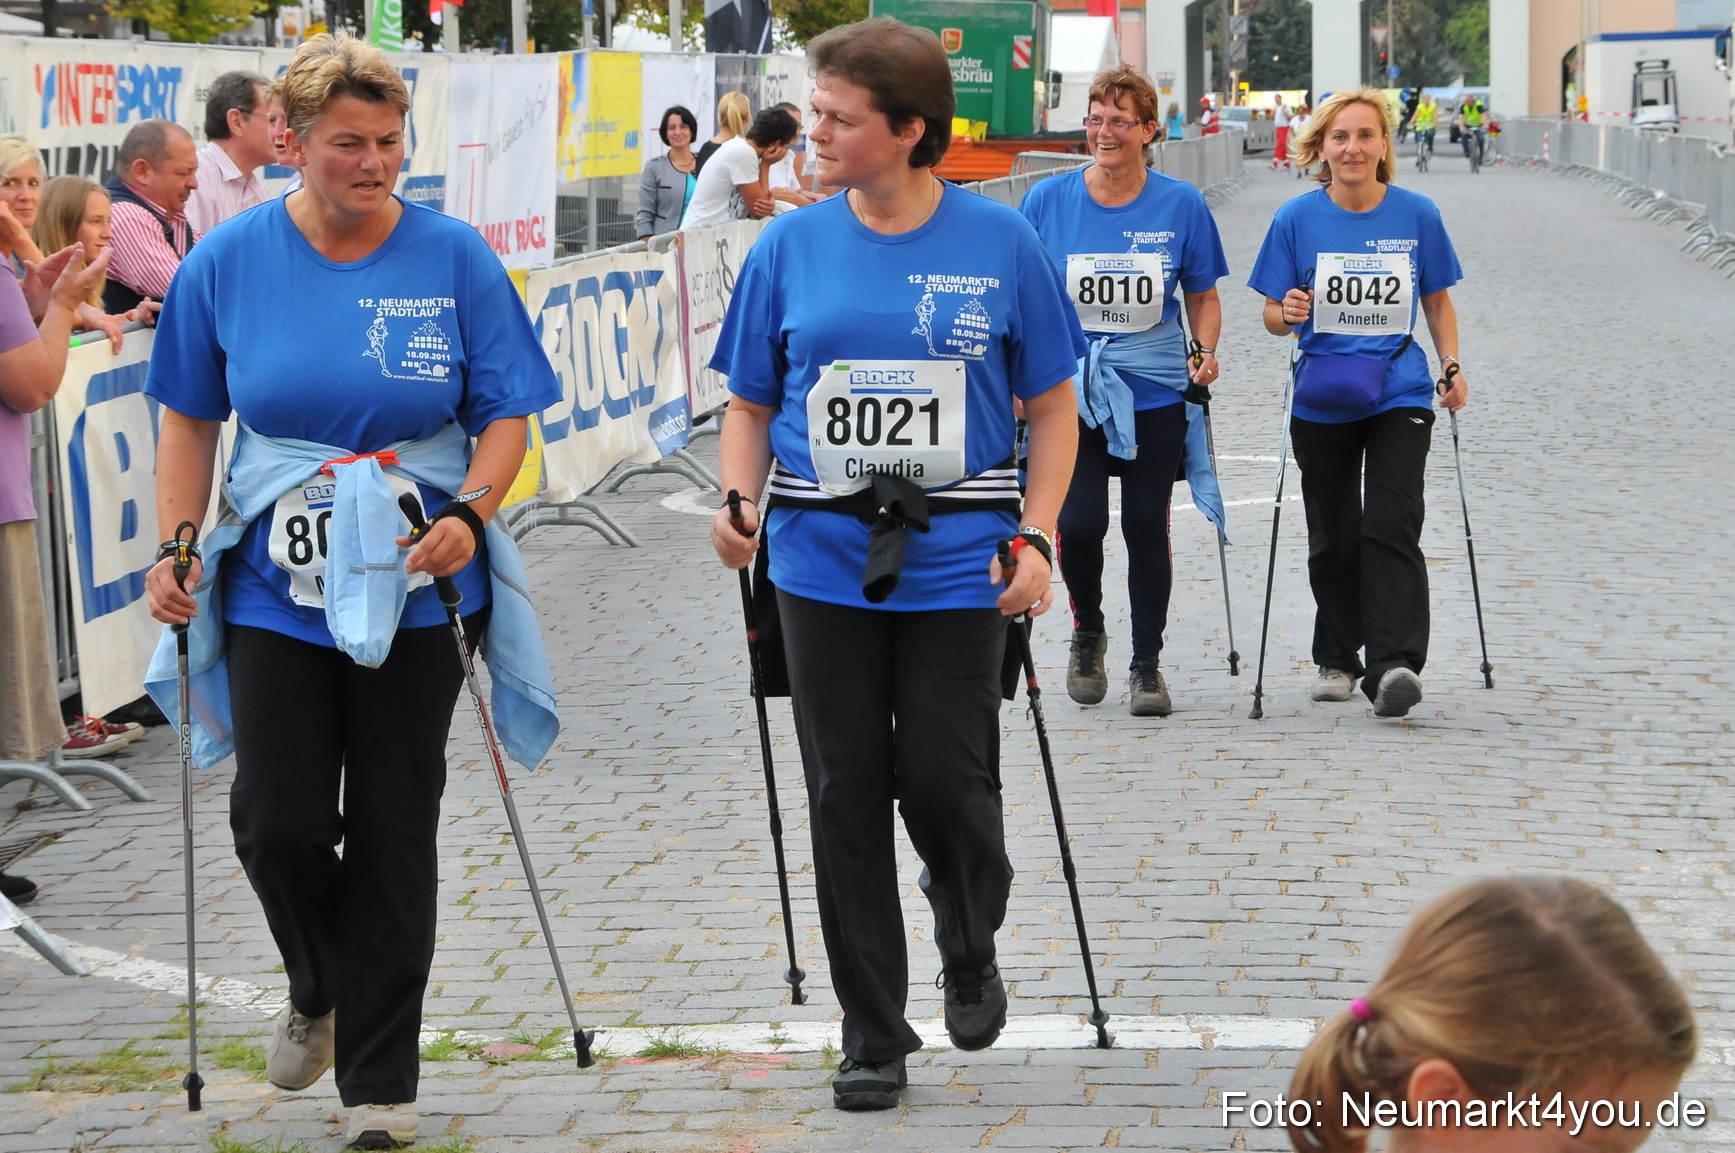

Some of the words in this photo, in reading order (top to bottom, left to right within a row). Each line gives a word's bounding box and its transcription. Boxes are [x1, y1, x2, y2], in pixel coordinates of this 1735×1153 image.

[951, 65, 993, 83] sbräu
[58, 63, 182, 127] INTERSPORT
[1095, 260, 1134, 269] BOCK
[1344, 260, 1383, 269] BOCK
[907, 274, 926, 284] 12.
[927, 274, 1000, 289] NEUMARKTER
[924, 283, 987, 295] STADTLAUF
[1078, 276, 1153, 305] 8010
[1326, 276, 1401, 306] 8042
[358, 298, 377, 308] 12.
[379, 297, 456, 308] NEUMARKTER
[376, 307, 442, 317] STADTLAUF
[1101, 310, 1130, 323] Rosi
[1338, 311, 1388, 325] Annette
[951, 328, 990, 340] 18.09.2011
[406, 351, 451, 361] 18.09.2011
[850, 370, 915, 384] BOCK
[826, 396, 940, 446] 8021
[845, 457, 925, 478] Claudia
[303, 483, 336, 501] BO
[285, 511, 333, 566] 80
